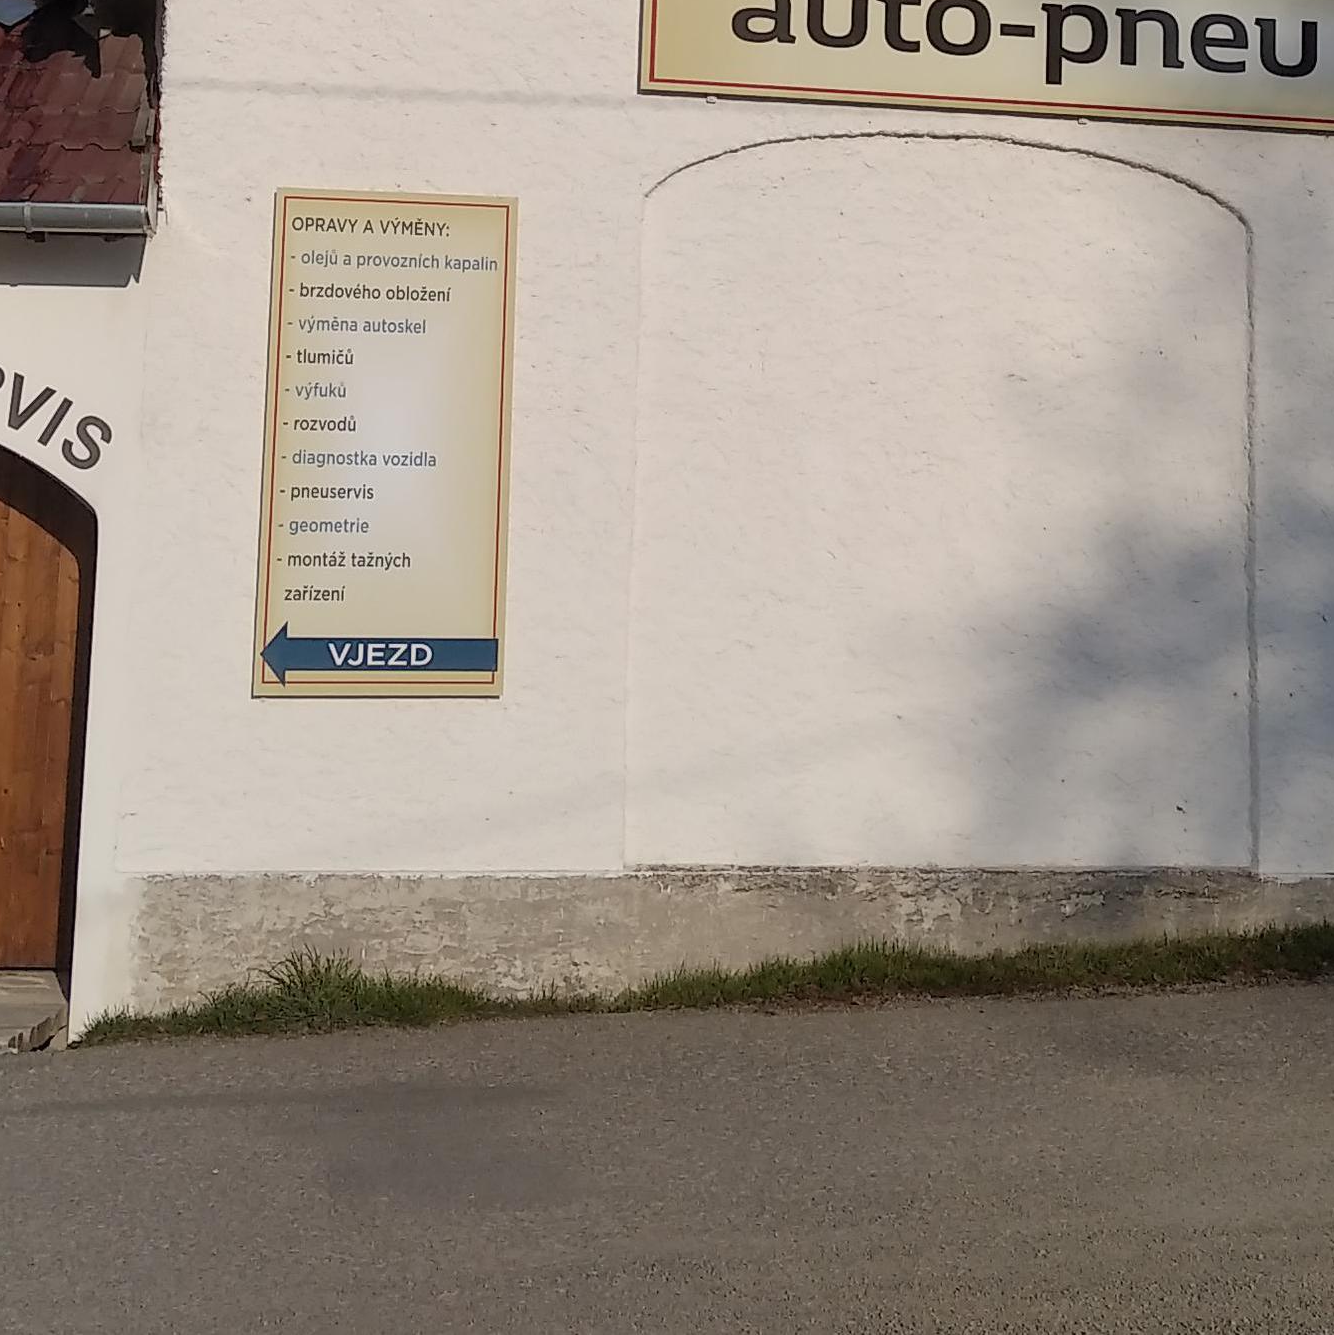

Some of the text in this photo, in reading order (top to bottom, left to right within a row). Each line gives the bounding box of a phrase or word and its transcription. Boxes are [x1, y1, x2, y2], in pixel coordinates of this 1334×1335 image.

[291, 216, 450, 237] OPRAVY A VÝMĚNY:
[301, 250, 338, 267] olejů
[343, 254, 351, 265] a
[356, 253, 439, 269] provozních
[444, 255, 498, 272] kapalin
[299, 282, 381, 299] brzdového
[386, 285, 451, 302] obložení
[299, 316, 357, 333] výměna
[363, 318, 426, 334] autoskel
[297, 349, 354, 365] tlumičů
[295, 381, 346, 400] výfuků
[293, 415, 356, 432] rozvodů
[292, 449, 377, 468] diagnostka
[382, 452, 437, 467] vozidla
[290, 484, 374, 501] pneuservis
[289, 518, 369, 535] geometrie
[287, 551, 346, 567] montáž
[351, 552, 411, 571] tažných
[284, 585, 346, 601] zařízení
[328, 643, 434, 666] VJEZD
